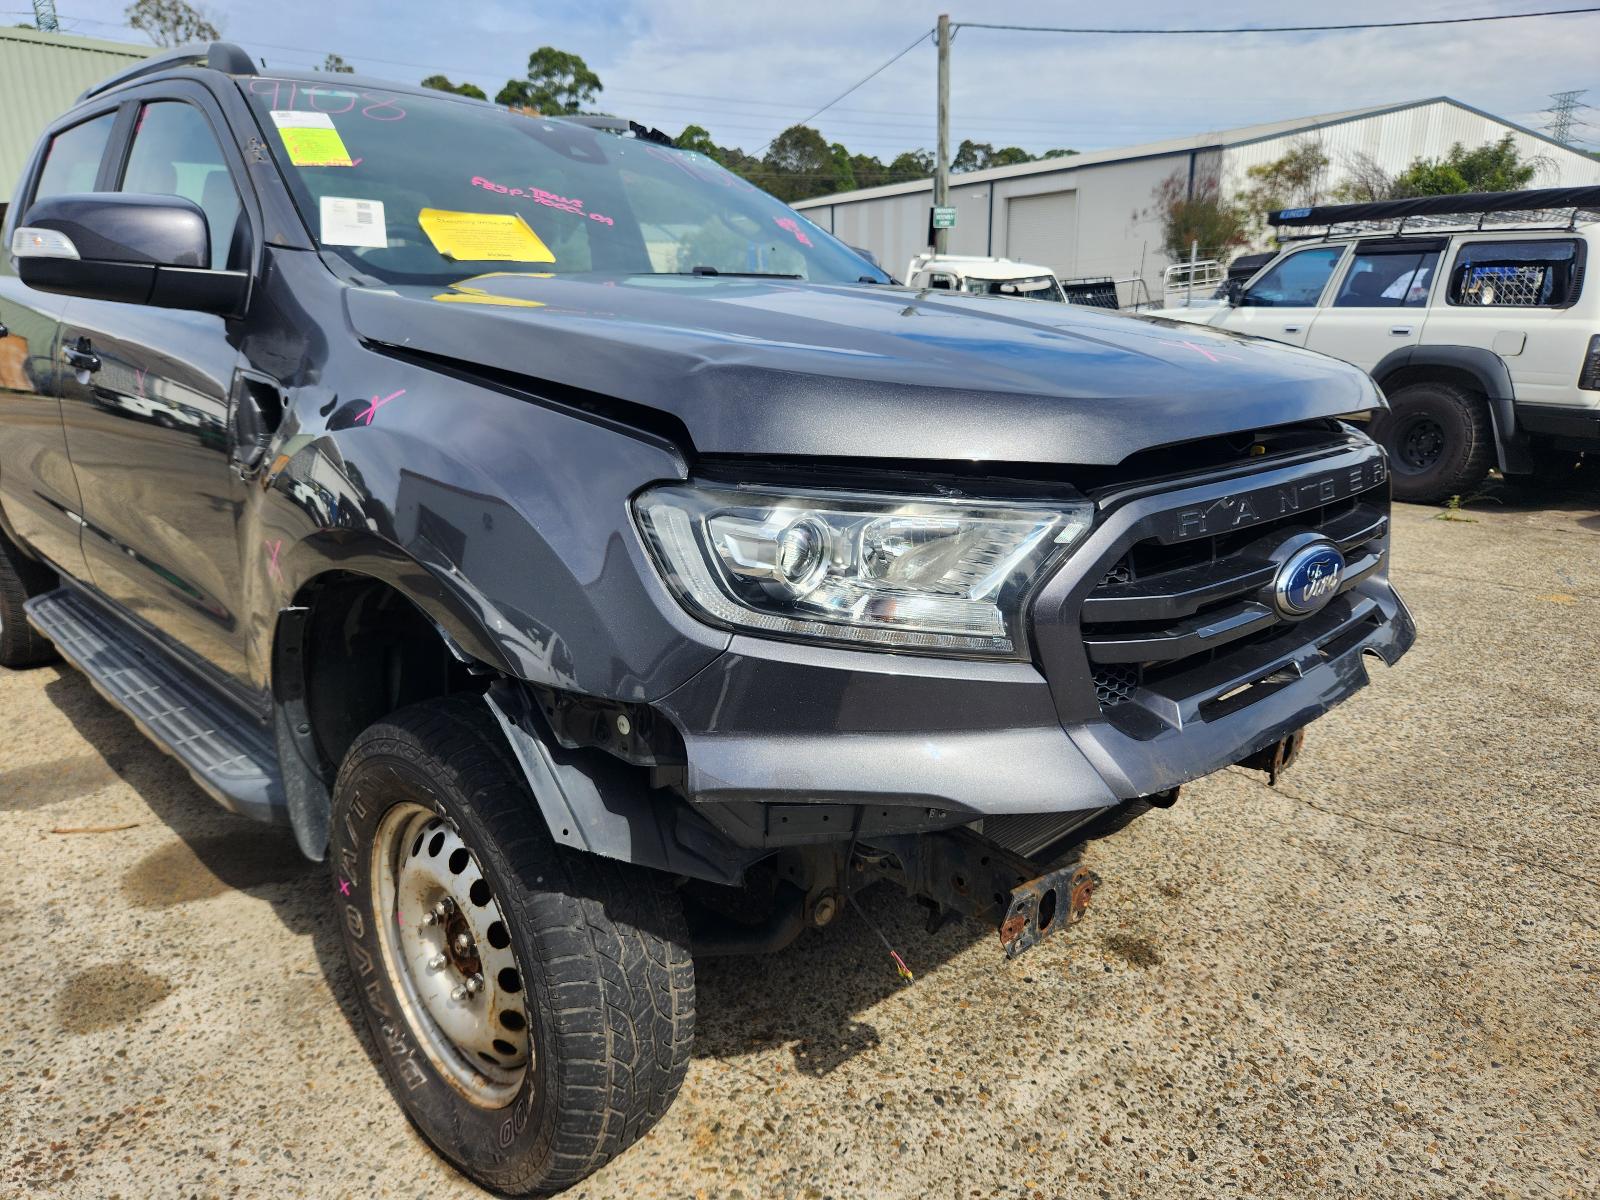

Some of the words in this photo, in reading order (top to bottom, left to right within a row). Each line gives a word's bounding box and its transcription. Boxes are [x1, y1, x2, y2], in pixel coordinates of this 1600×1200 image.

[249, 79, 407, 121] 9108
[1176, 463, 1386, 537] RANGER
[1302, 558, 1340, 602] Ford
[346, 904, 428, 1091] BRAVO
